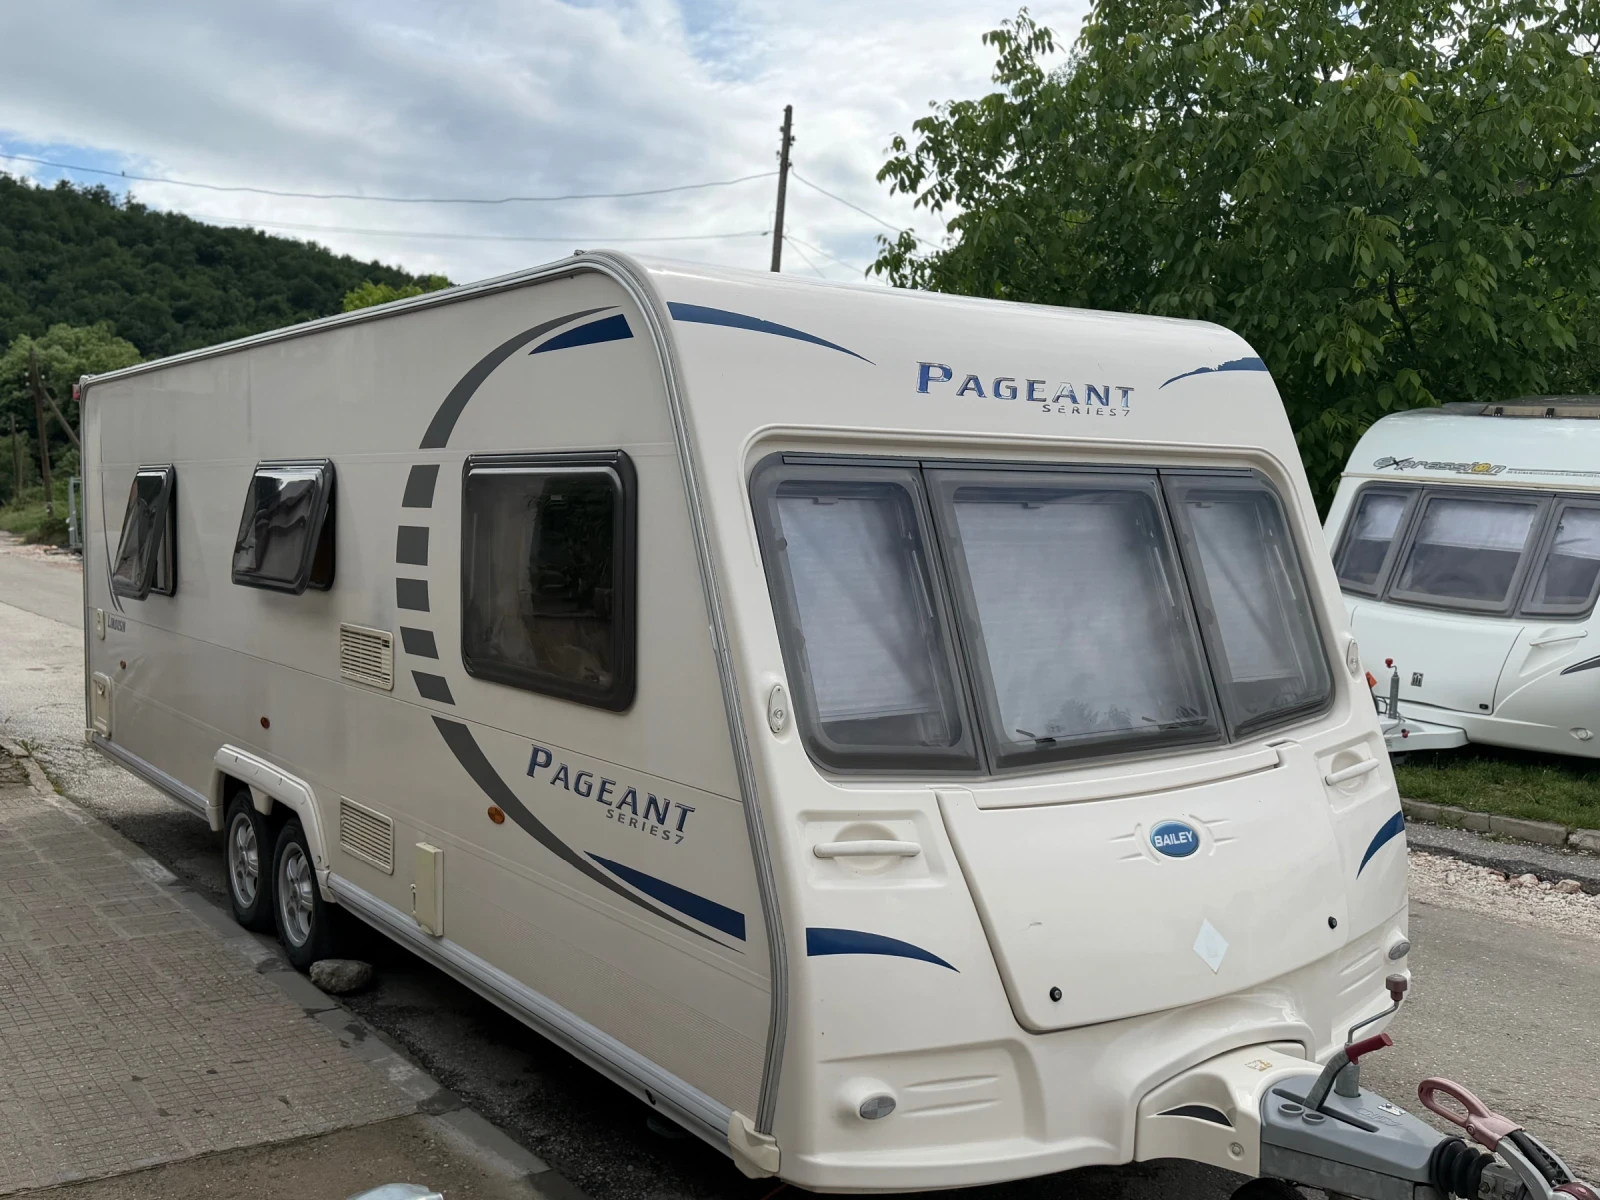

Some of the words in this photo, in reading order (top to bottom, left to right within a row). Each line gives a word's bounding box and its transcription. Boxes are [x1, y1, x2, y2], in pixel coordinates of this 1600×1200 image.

[916, 361, 1135, 408] PAGEANT
[526, 744, 696, 833] PAGEANT
[1154, 830, 1193, 847] BAILEY
